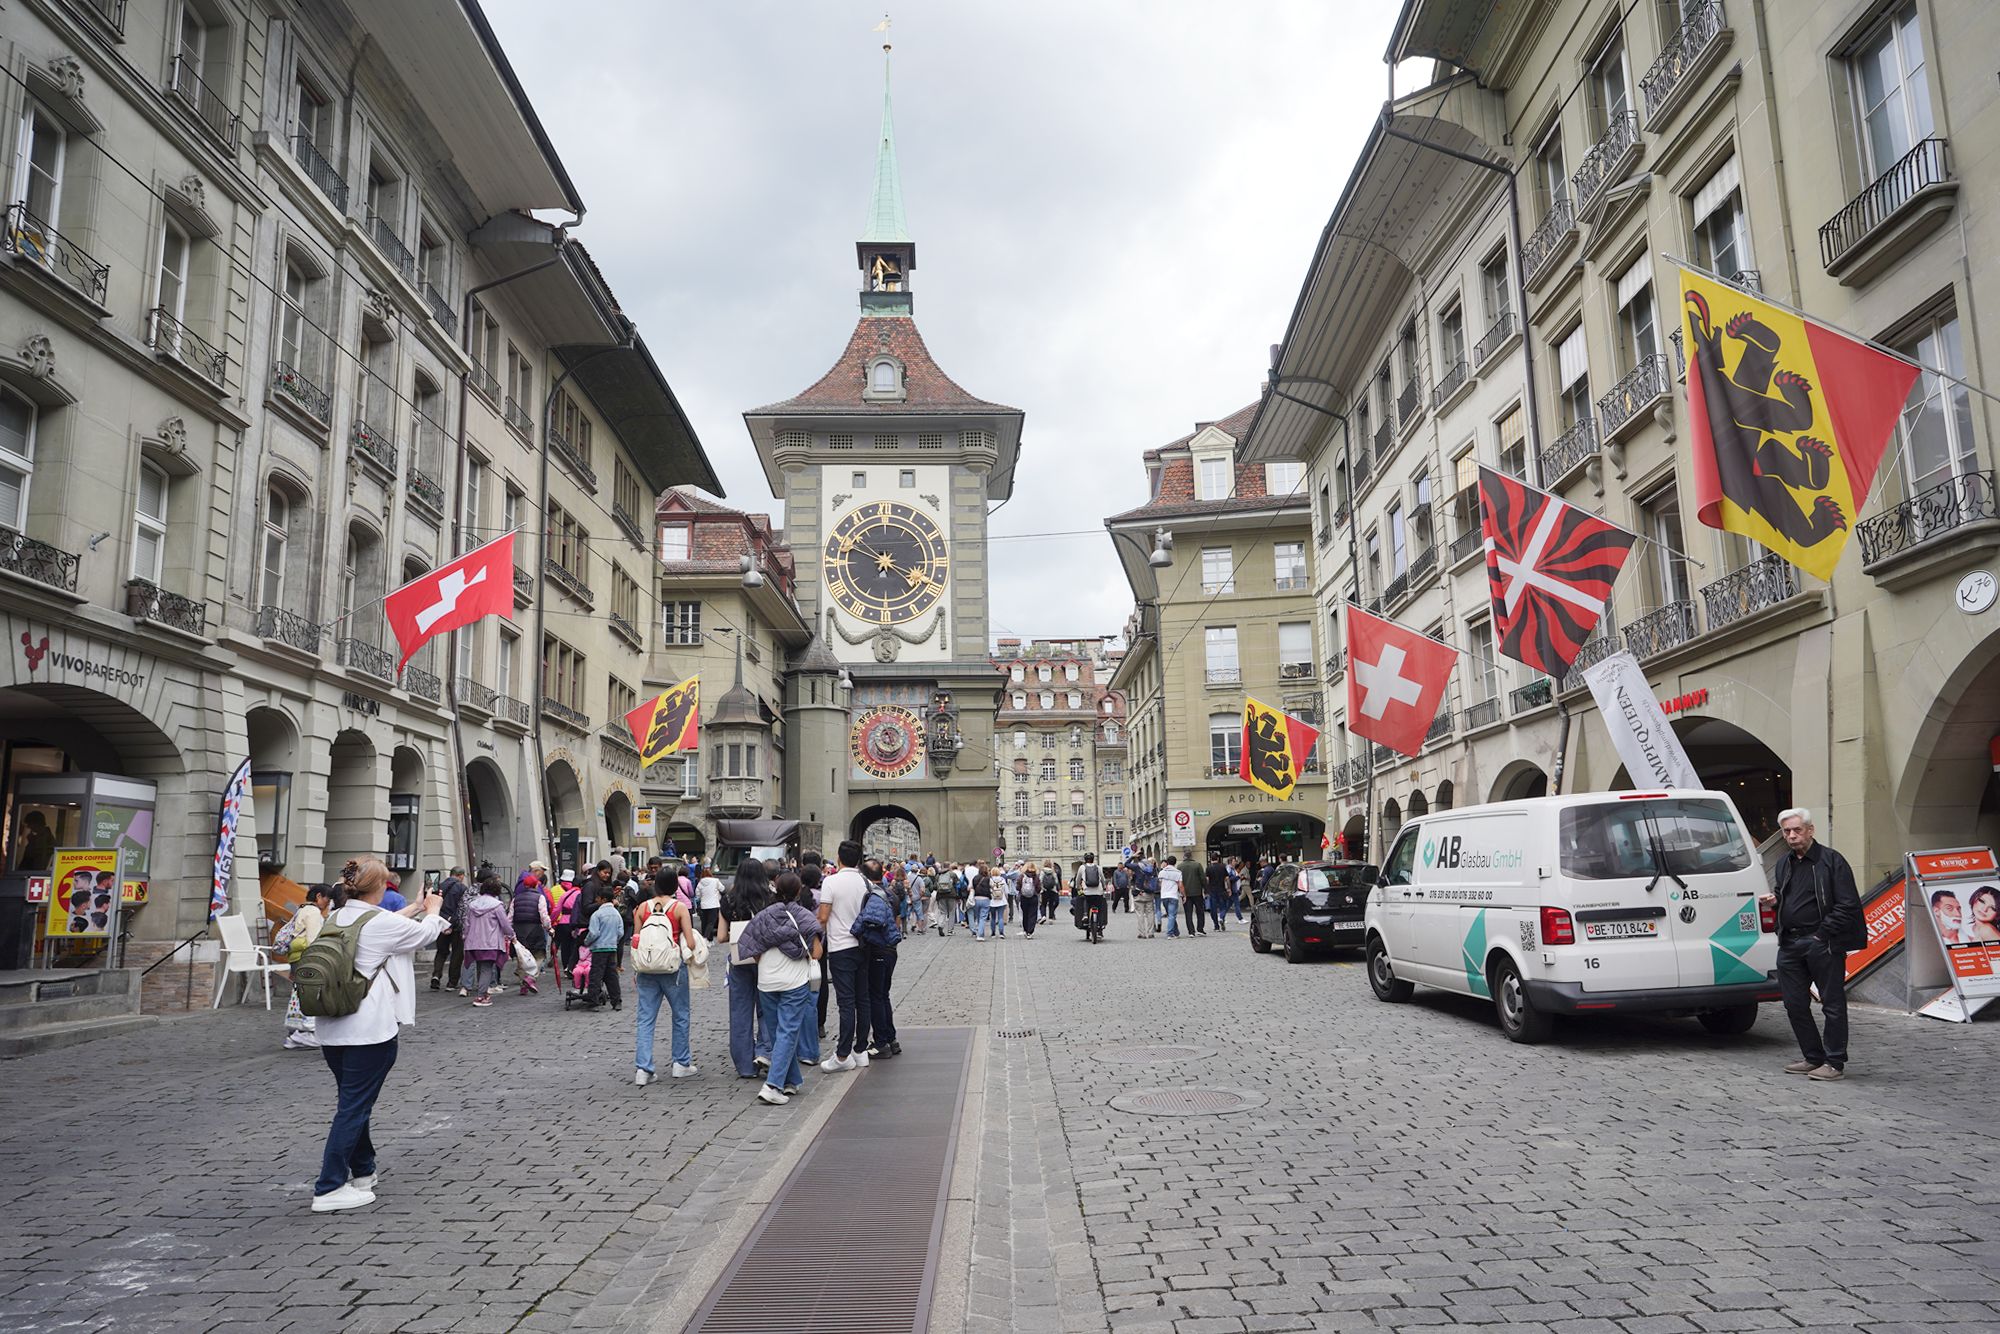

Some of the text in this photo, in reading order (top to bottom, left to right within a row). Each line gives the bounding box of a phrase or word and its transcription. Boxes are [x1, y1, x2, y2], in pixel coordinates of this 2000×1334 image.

[51, 651, 145, 688] VIVOBAREFOOT
[1660, 688, 1707, 715] AMMUT
[1228, 792, 1305, 803] APOTHKE
[1436, 836, 1523, 869] AB Glasbau GmbH
[1468, 890, 1477, 900] 332
[1478, 890, 1485, 900] 60
[1486, 890, 1493, 900] 00
[1682, 890, 1699, 900] AB
[1866, 893, 1902, 921] COIFFEUR
[1866, 899, 1905, 941] NEWR
[1584, 958, 1600, 969] 16
